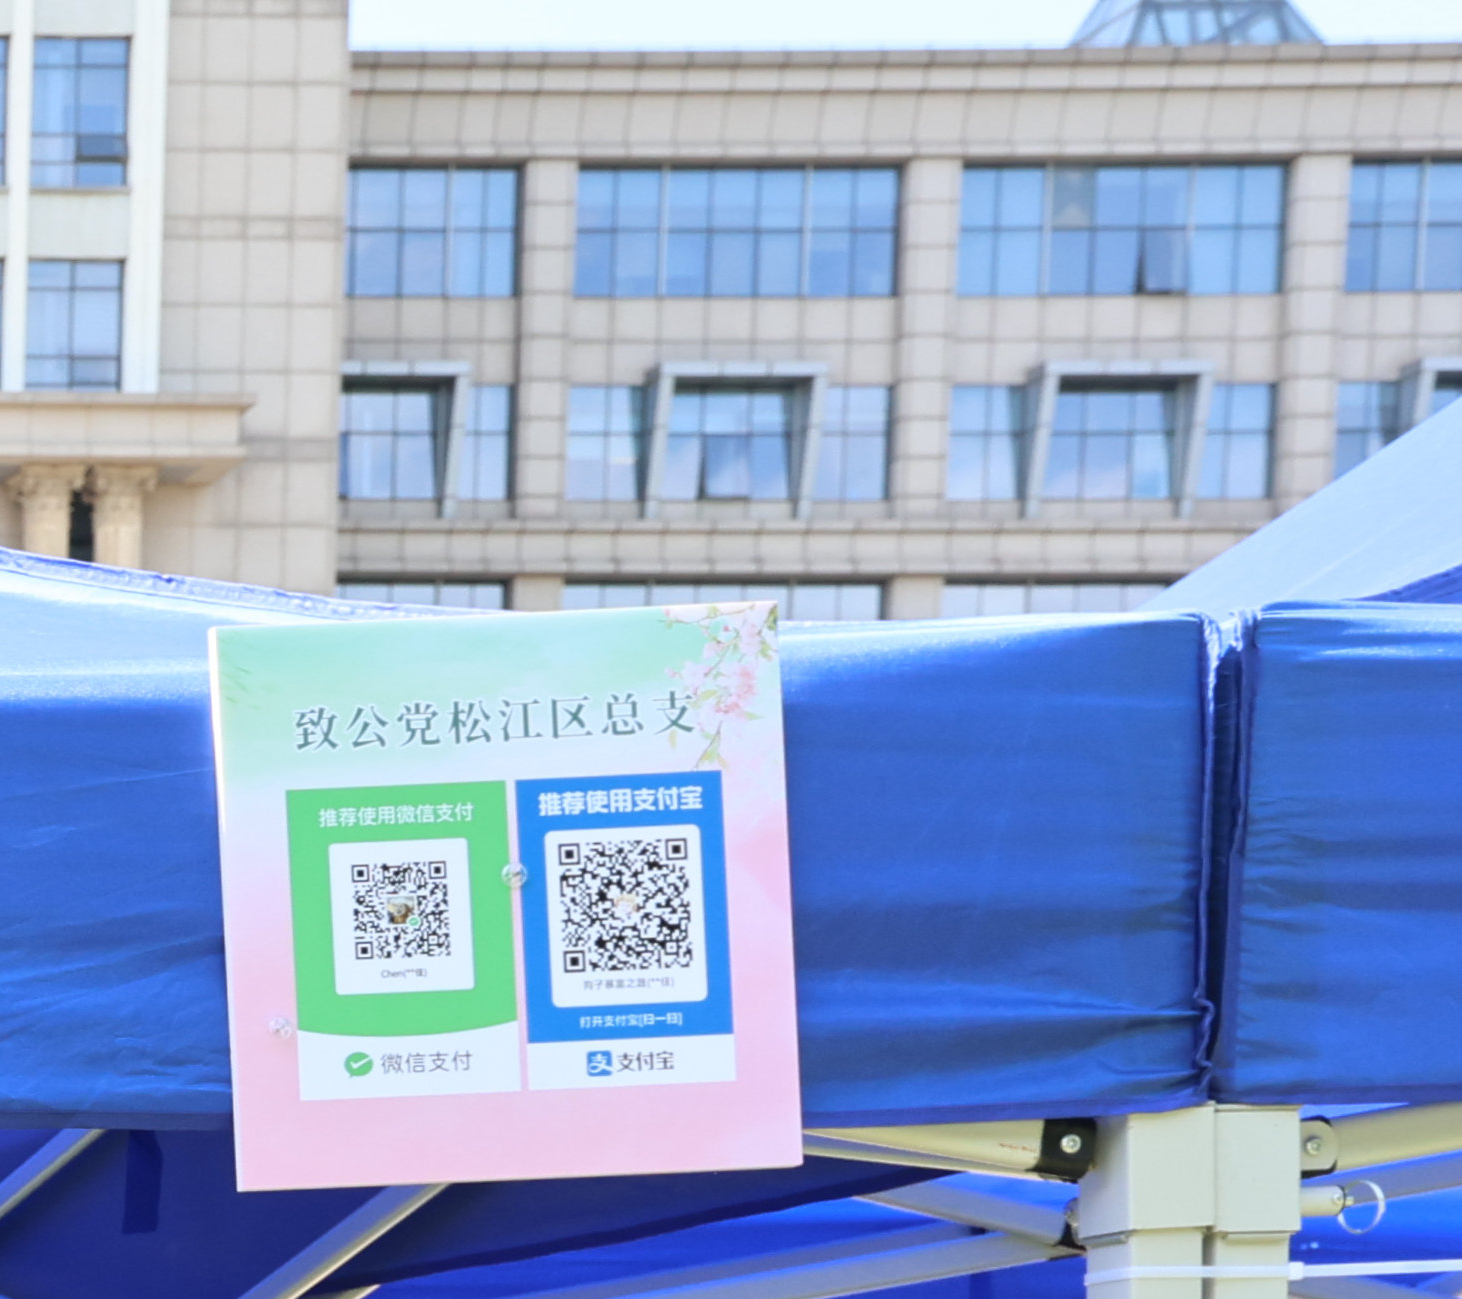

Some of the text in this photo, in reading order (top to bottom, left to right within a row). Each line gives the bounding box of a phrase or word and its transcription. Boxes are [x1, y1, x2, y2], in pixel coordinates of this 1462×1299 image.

[293, 689, 697, 754] 致公党松江区总支
[318, 801, 475, 829] 推荐使用微信支付
[537, 785, 705, 817] 推荐使用支付宝
[381, 1050, 472, 1074] 微信支付
[616, 1050, 675, 1072] 支付宝
